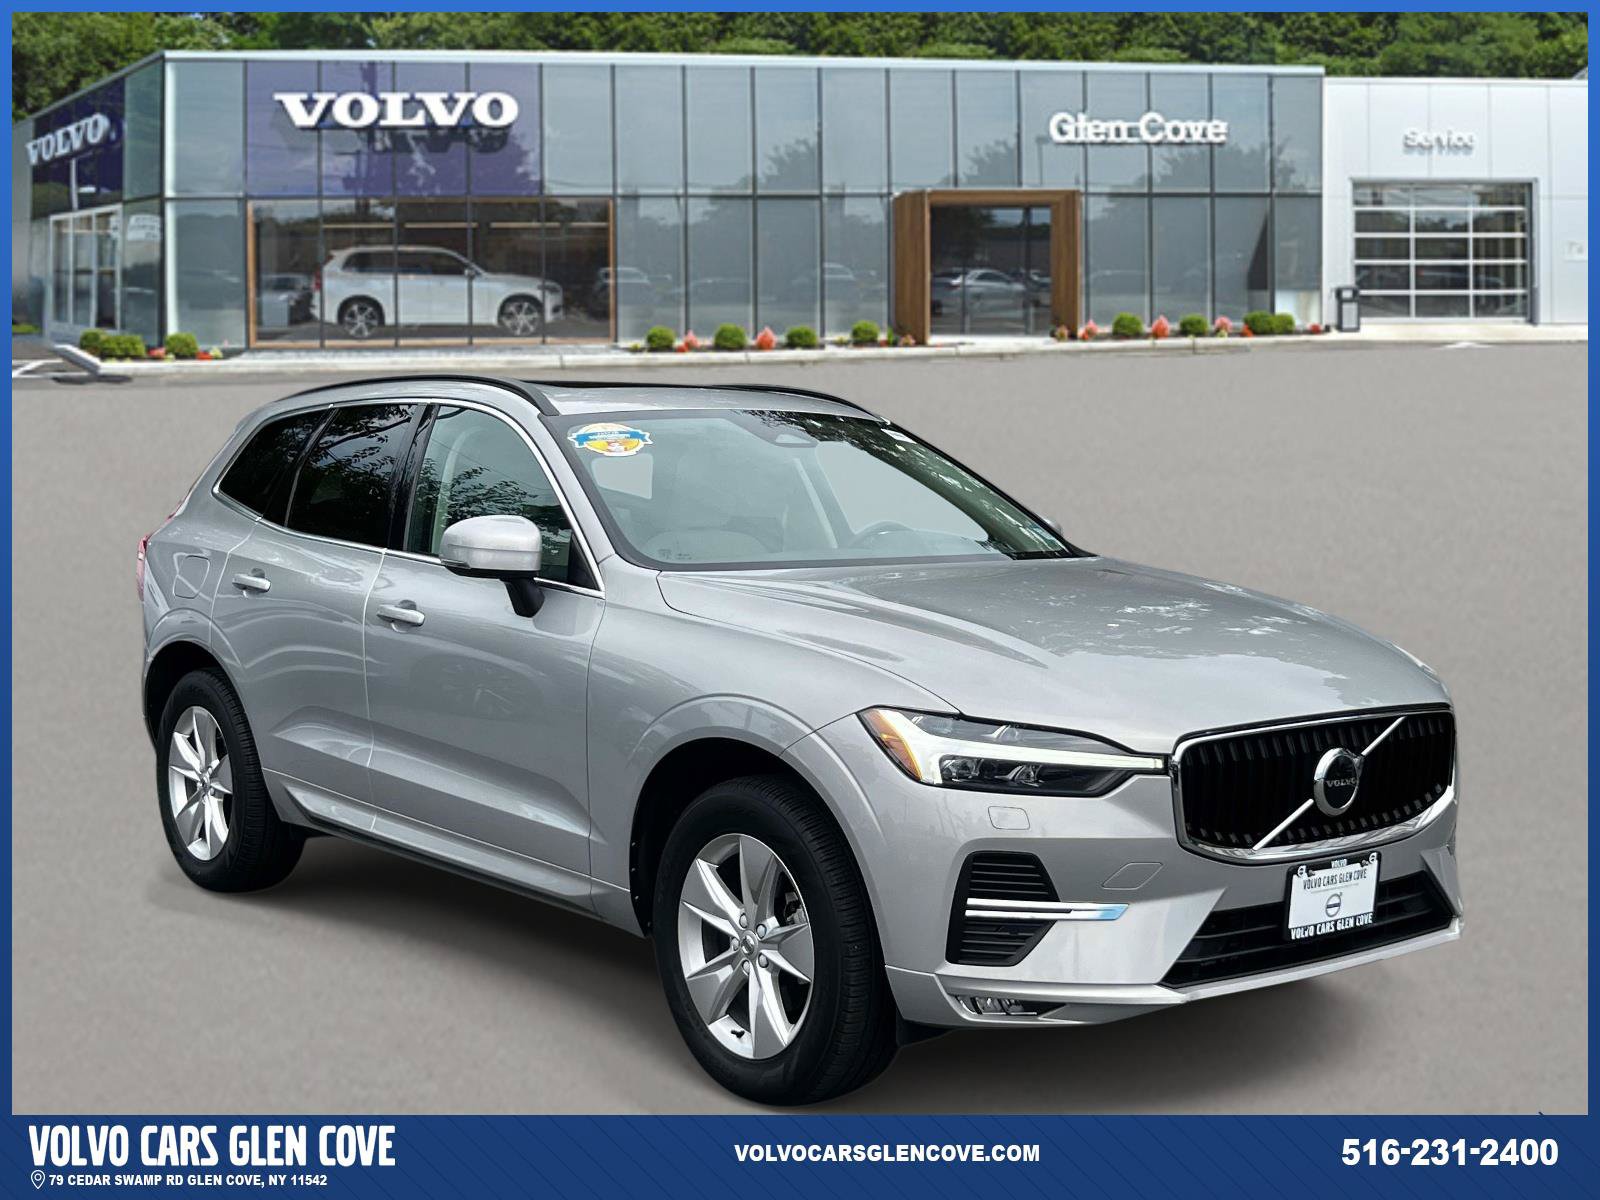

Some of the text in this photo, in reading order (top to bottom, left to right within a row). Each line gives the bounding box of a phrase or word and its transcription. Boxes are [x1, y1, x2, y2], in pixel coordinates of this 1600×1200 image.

[273, 92, 519, 127] VOLVO
[26, 113, 110, 166] VOLVO
[1049, 111, 1228, 144] Glen Cove
[1402, 127, 1477, 154] Service
[1326, 777, 1357, 788] VOLVO
[1303, 877, 1321, 890] VOLVO
[1322, 874, 1338, 887] CARS
[1339, 871, 1352, 883] GLEN
[1353, 868, 1367, 880] COVE
[1291, 913, 1373, 940] VOLVO CARS GLEN COVE
